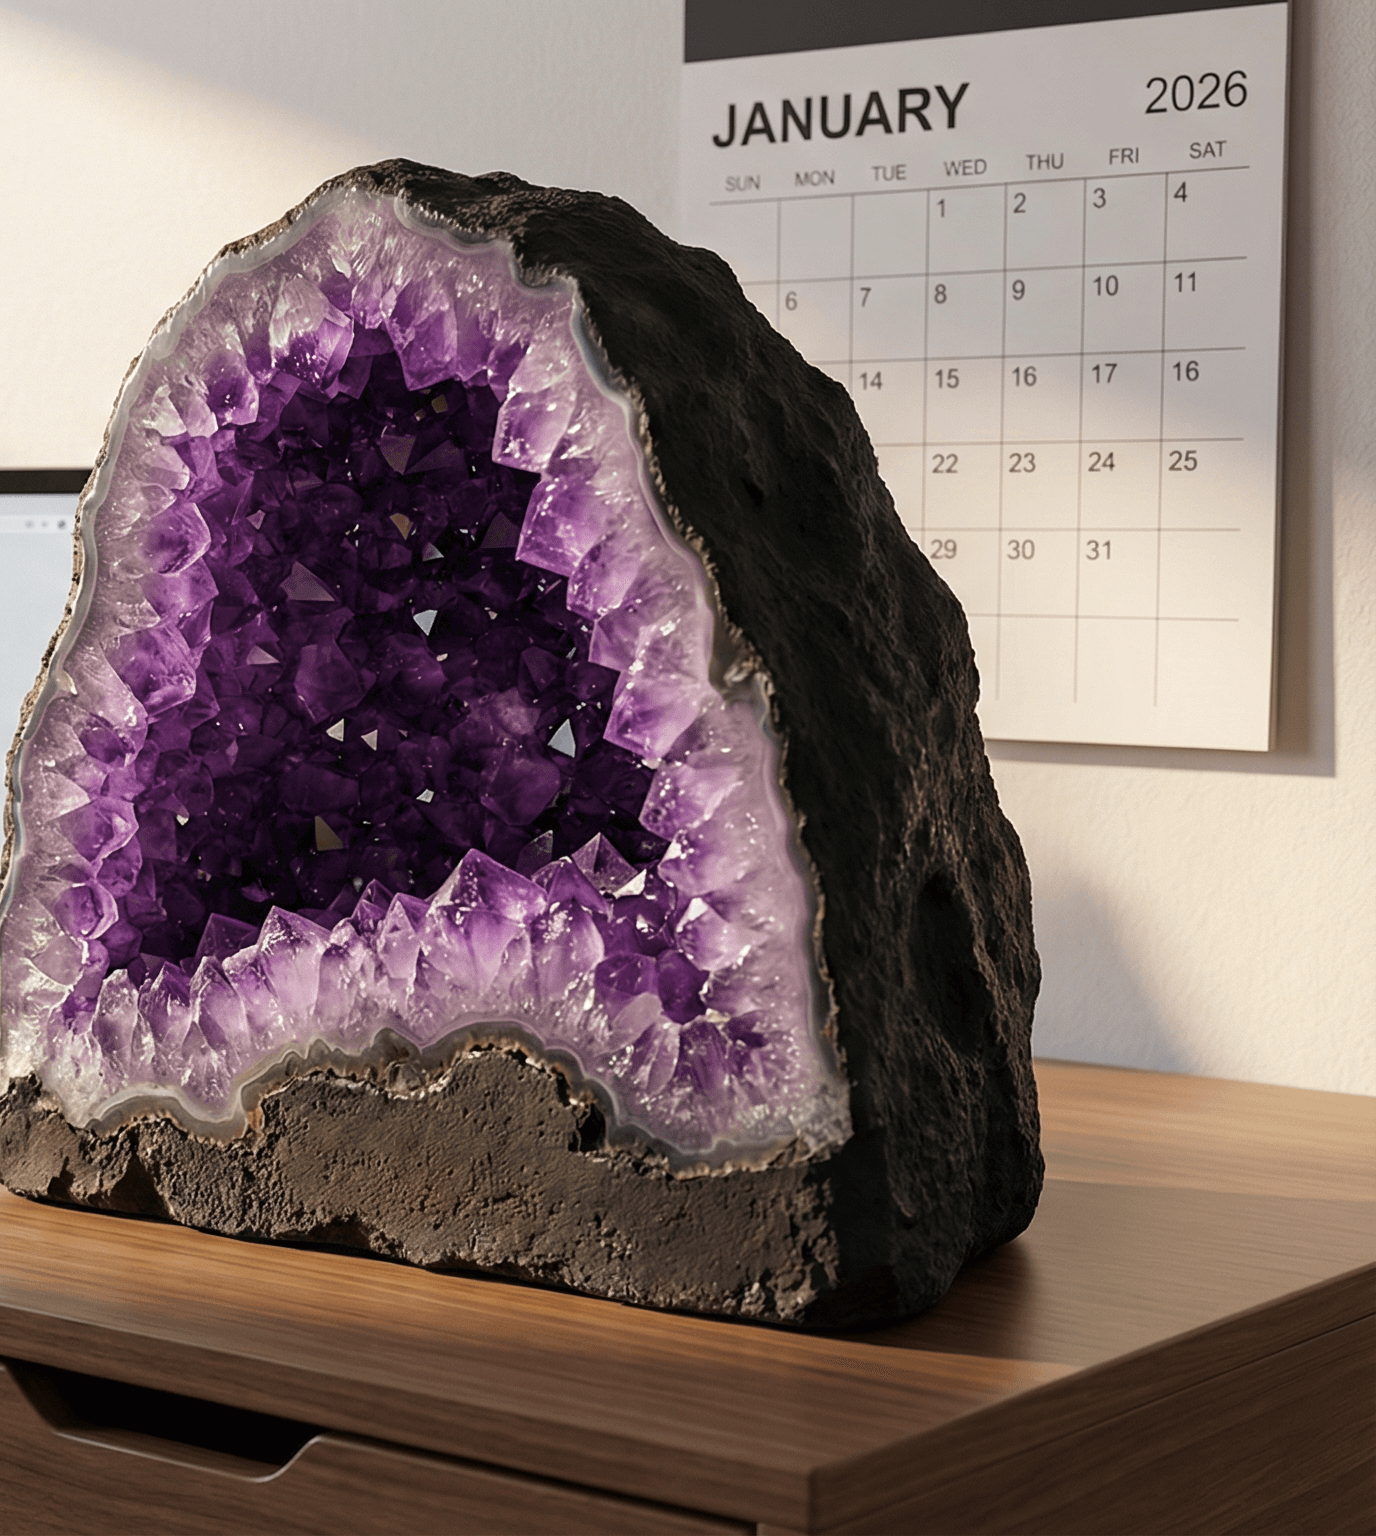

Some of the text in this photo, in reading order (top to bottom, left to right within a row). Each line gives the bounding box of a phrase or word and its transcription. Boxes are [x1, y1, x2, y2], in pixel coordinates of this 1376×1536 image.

[712, 69, 1248, 149] JANUARY 2026
[726, 140, 1227, 192] SUN MON TUE WED THU FRI SAT
[935, 181, 1188, 218] 1 2 3 4
[784, 271, 1196, 312] 6 7 8 9 10 11
[859, 360, 1200, 391] 14 15 16 17 16
[932, 449, 1198, 474] 22 23 24 25
[930, 538, 1111, 561] 29 30 31
